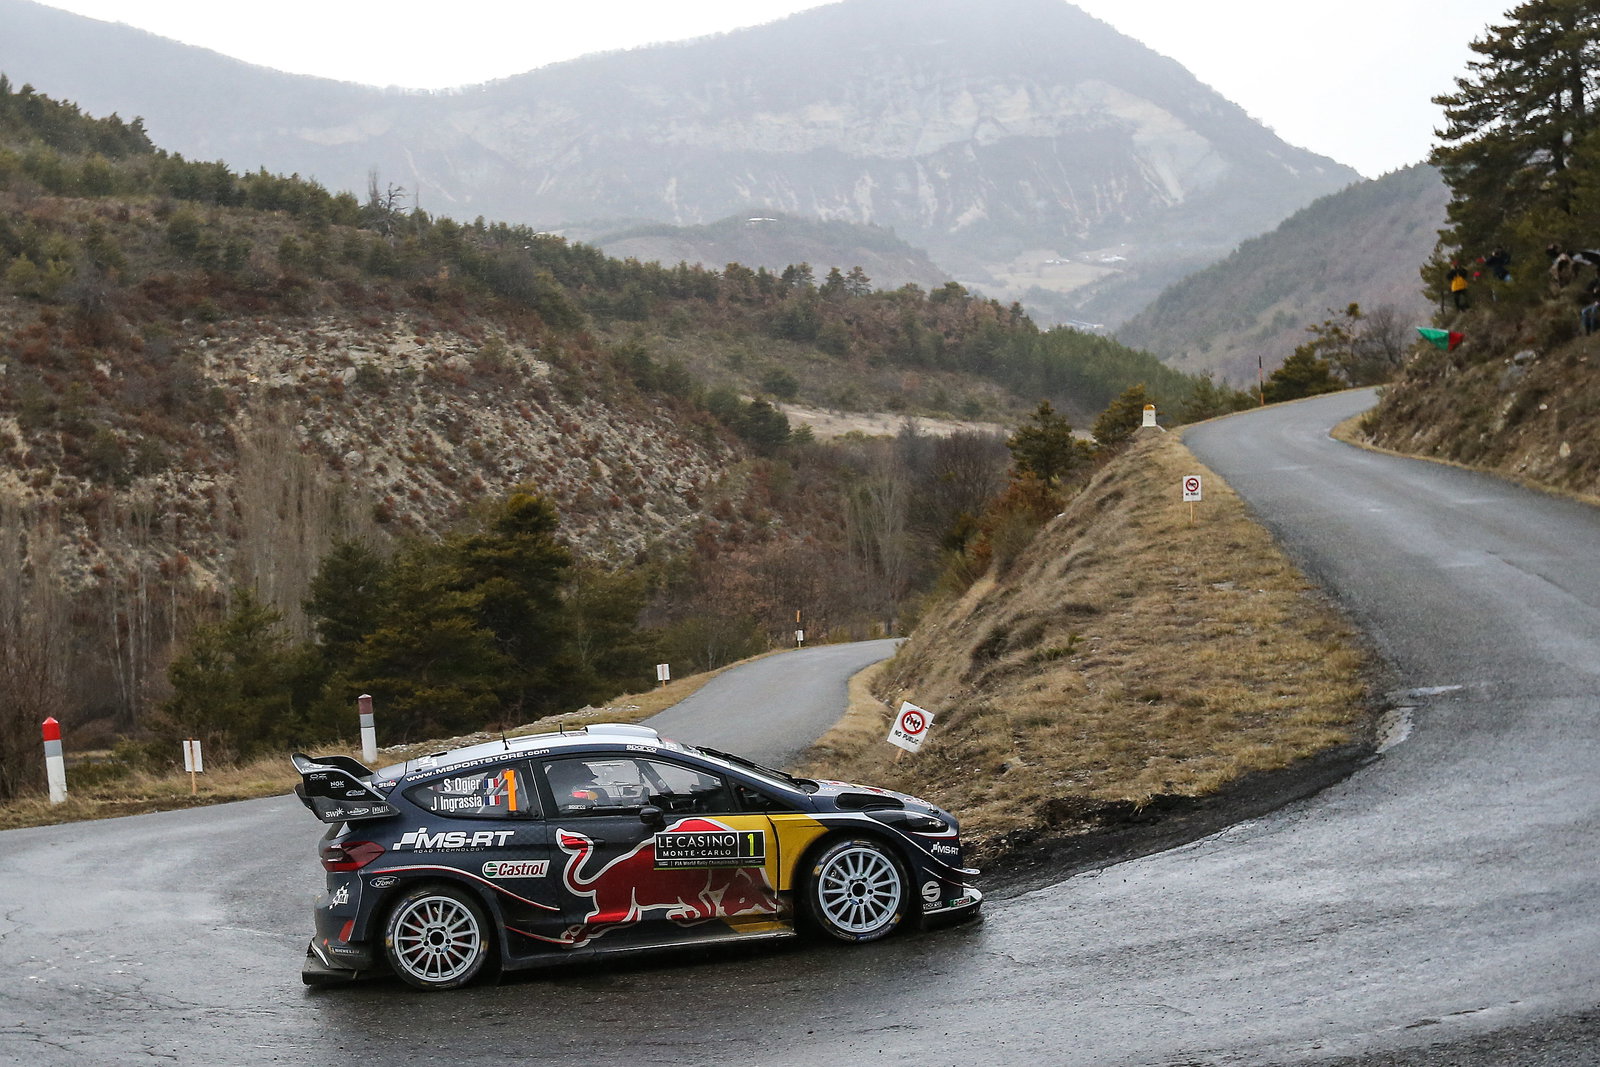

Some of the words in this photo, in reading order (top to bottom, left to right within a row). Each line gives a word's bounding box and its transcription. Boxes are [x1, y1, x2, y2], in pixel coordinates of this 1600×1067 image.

[902, 733, 919, 745] PUBLIC
[443, 778, 452, 792] S
[454, 777, 481, 793] Ogier
[503, 769, 517, 811] 1
[431, 797, 438, 811] J
[440, 794, 483, 812] Ingrassia
[414, 831, 515, 849] MS-RT
[658, 836, 673, 848] LE
[676, 835, 735, 848] CASINO
[747, 833, 754, 856] 1
[498, 862, 545, 876] Castrol
[375, 879, 395, 887] Ford
